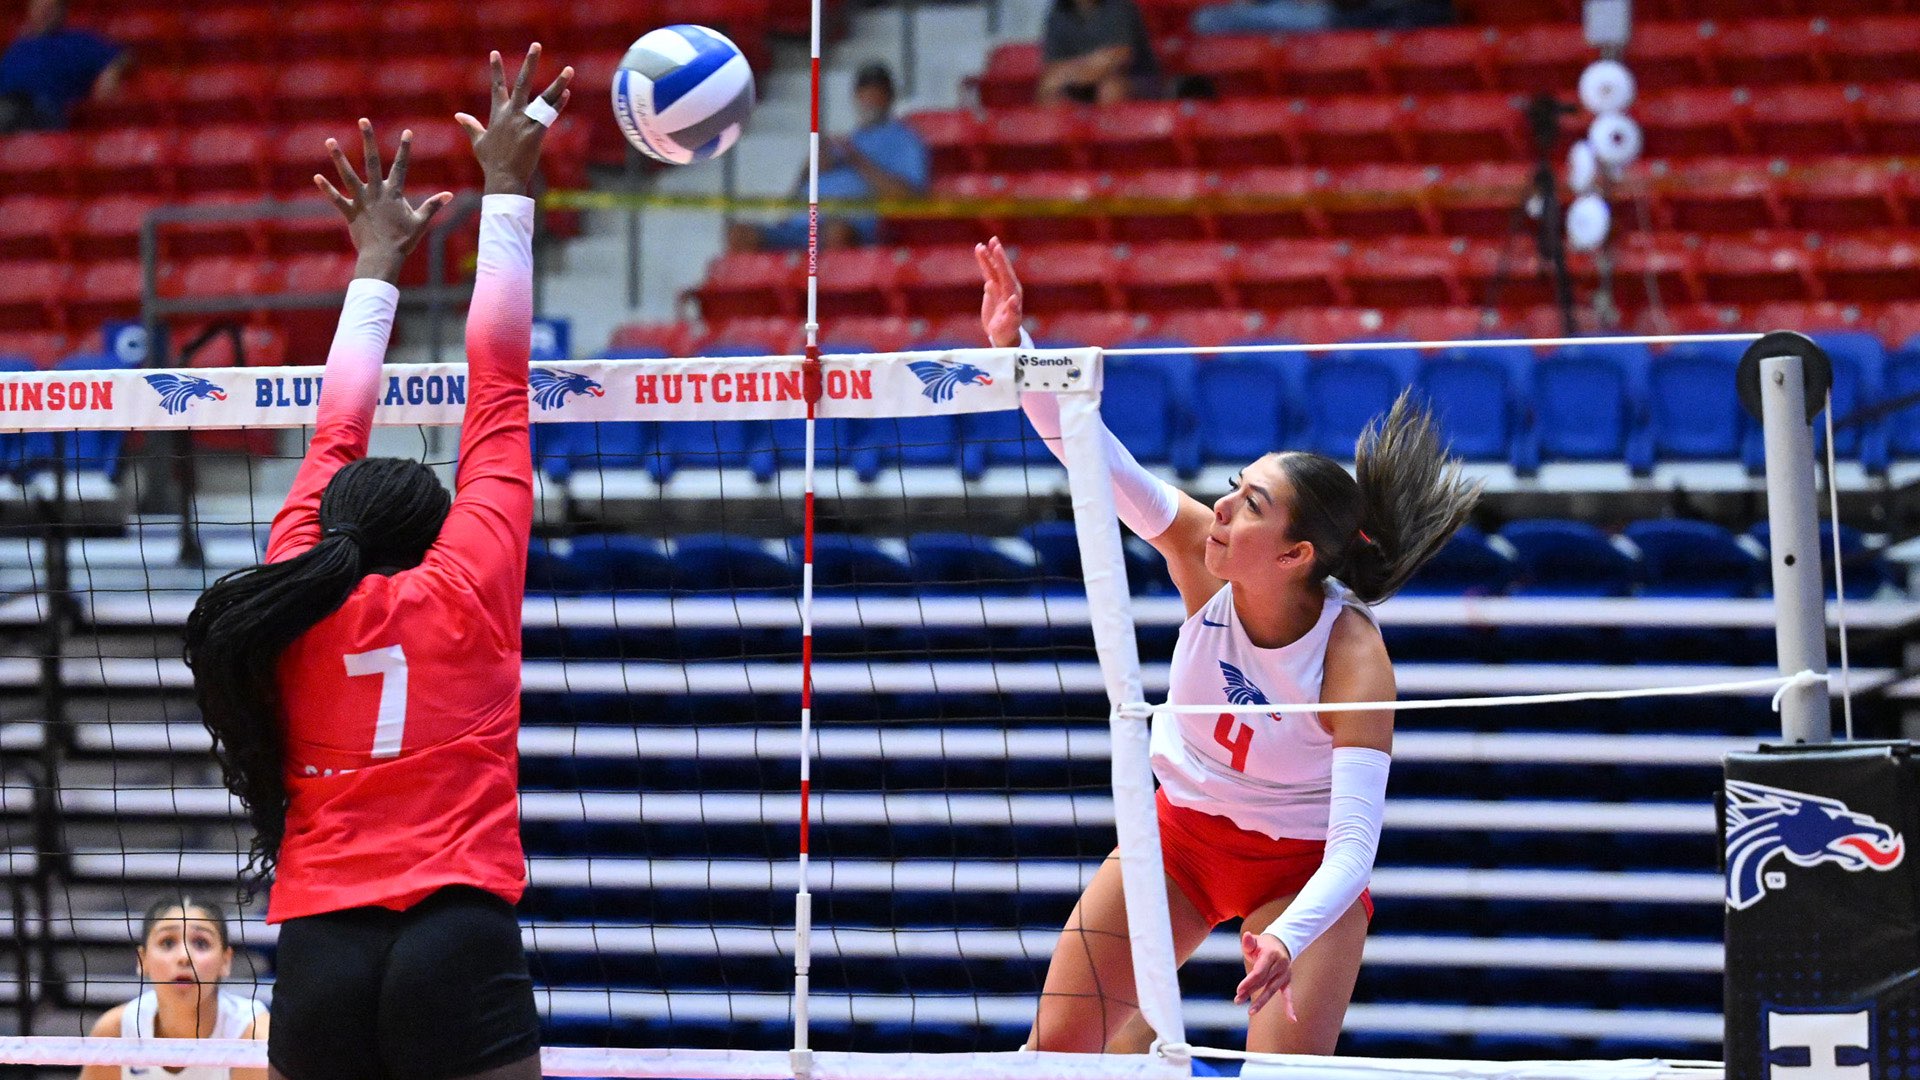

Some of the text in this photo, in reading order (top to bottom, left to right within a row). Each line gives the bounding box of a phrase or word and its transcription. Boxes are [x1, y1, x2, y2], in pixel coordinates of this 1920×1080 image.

[808, 236, 818, 274] imports
[1030, 356, 1073, 367] Senoh
[635, 370, 873, 404] HUTCHINON
[343, 644, 408, 759] 7
[1213, 712, 1255, 773] 4
